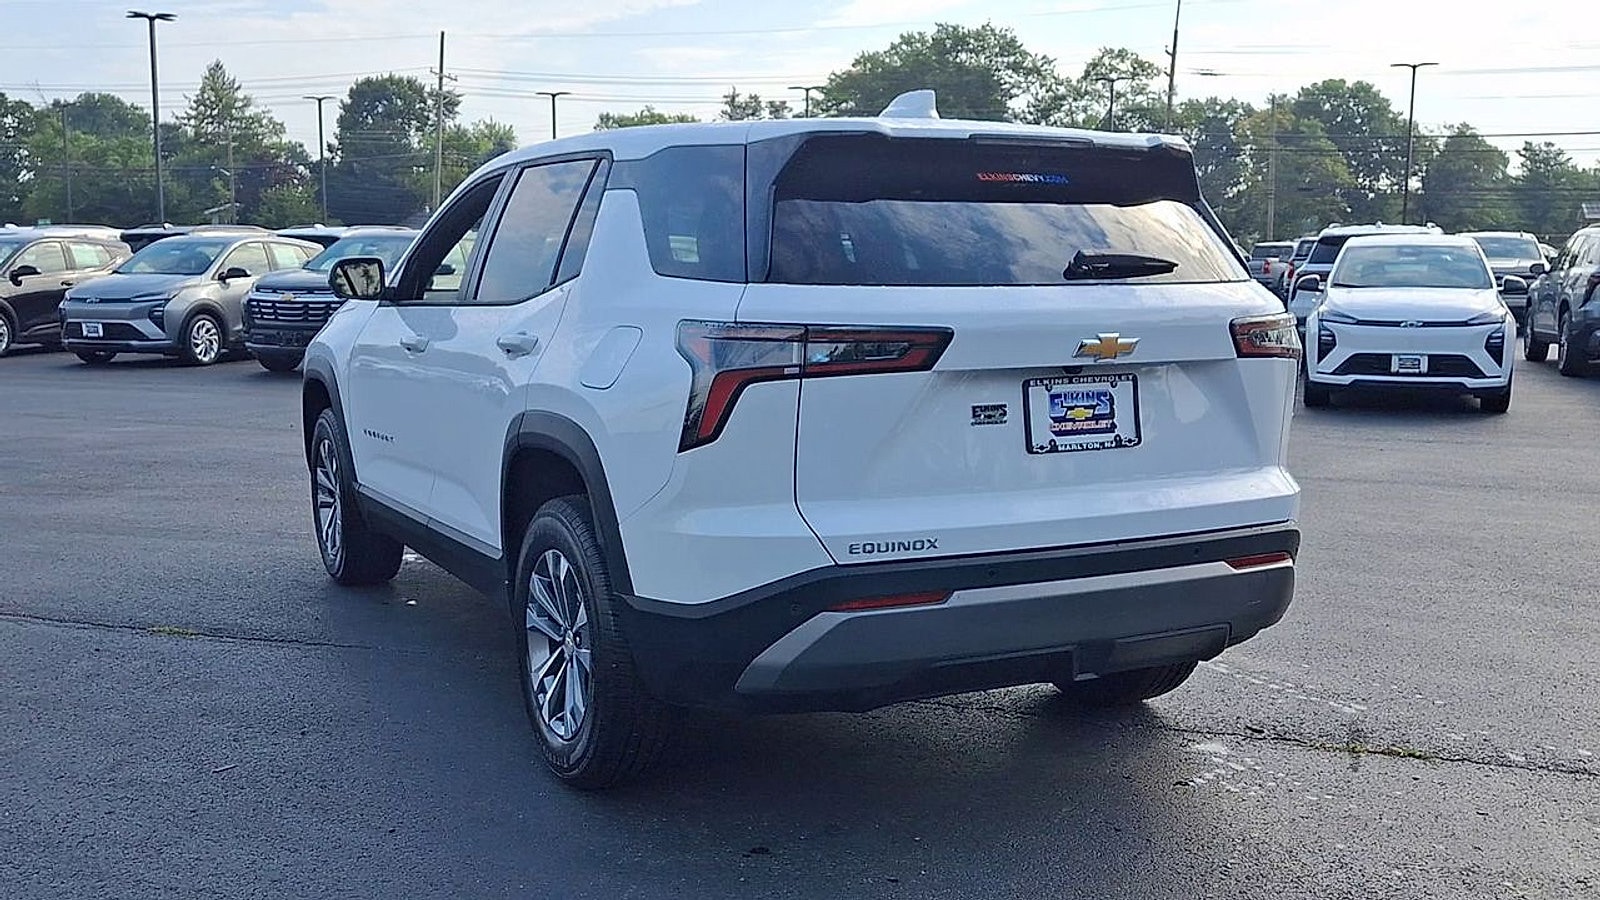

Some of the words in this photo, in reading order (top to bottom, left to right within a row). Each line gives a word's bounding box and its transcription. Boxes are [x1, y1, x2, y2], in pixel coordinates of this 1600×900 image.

[1029, 378, 1069, 386] ELKINS
[1072, 374, 1134, 384] CHEVROLET
[1049, 390, 1110, 416] ELKINS
[1058, 441, 1103, 451] MARLTON,
[1104, 441, 1116, 449] NJ
[848, 538, 939, 555] EQUINOX
